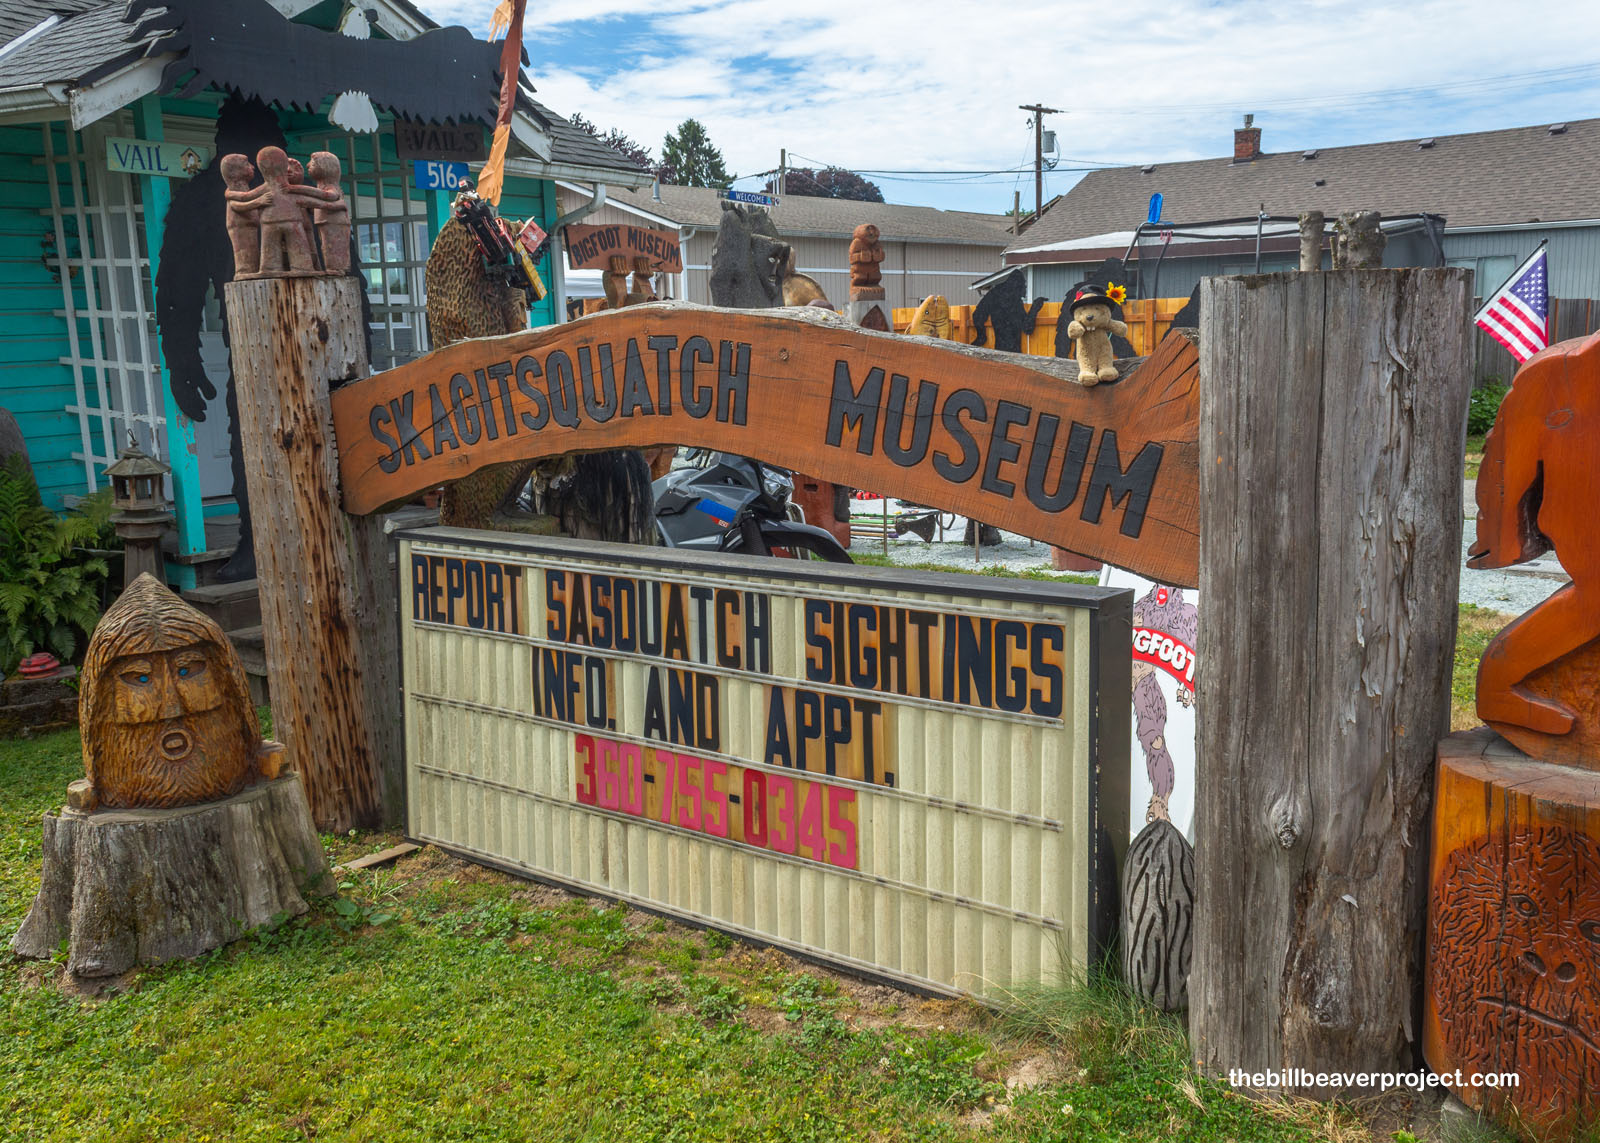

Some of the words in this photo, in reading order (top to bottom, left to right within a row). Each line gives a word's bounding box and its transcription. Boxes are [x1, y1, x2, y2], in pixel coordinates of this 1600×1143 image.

[113, 143, 168, 171] VAIL
[427, 162, 457, 189] 516
[735, 192, 765, 204] WELCOME
[571, 226, 621, 266] BIGFOOT
[627, 227, 680, 266] MUSEUM
[369, 335, 752, 474] SKAGITSQUATCH
[825, 360, 1165, 539] MUSEUM
[413, 555, 523, 635] REPORT
[546, 569, 769, 673] SASQUATCH
[805, 600, 1064, 717] SIGHTINGS
[643, 666, 720, 751] AND
[575, 734, 857, 870] 360-755-0345
